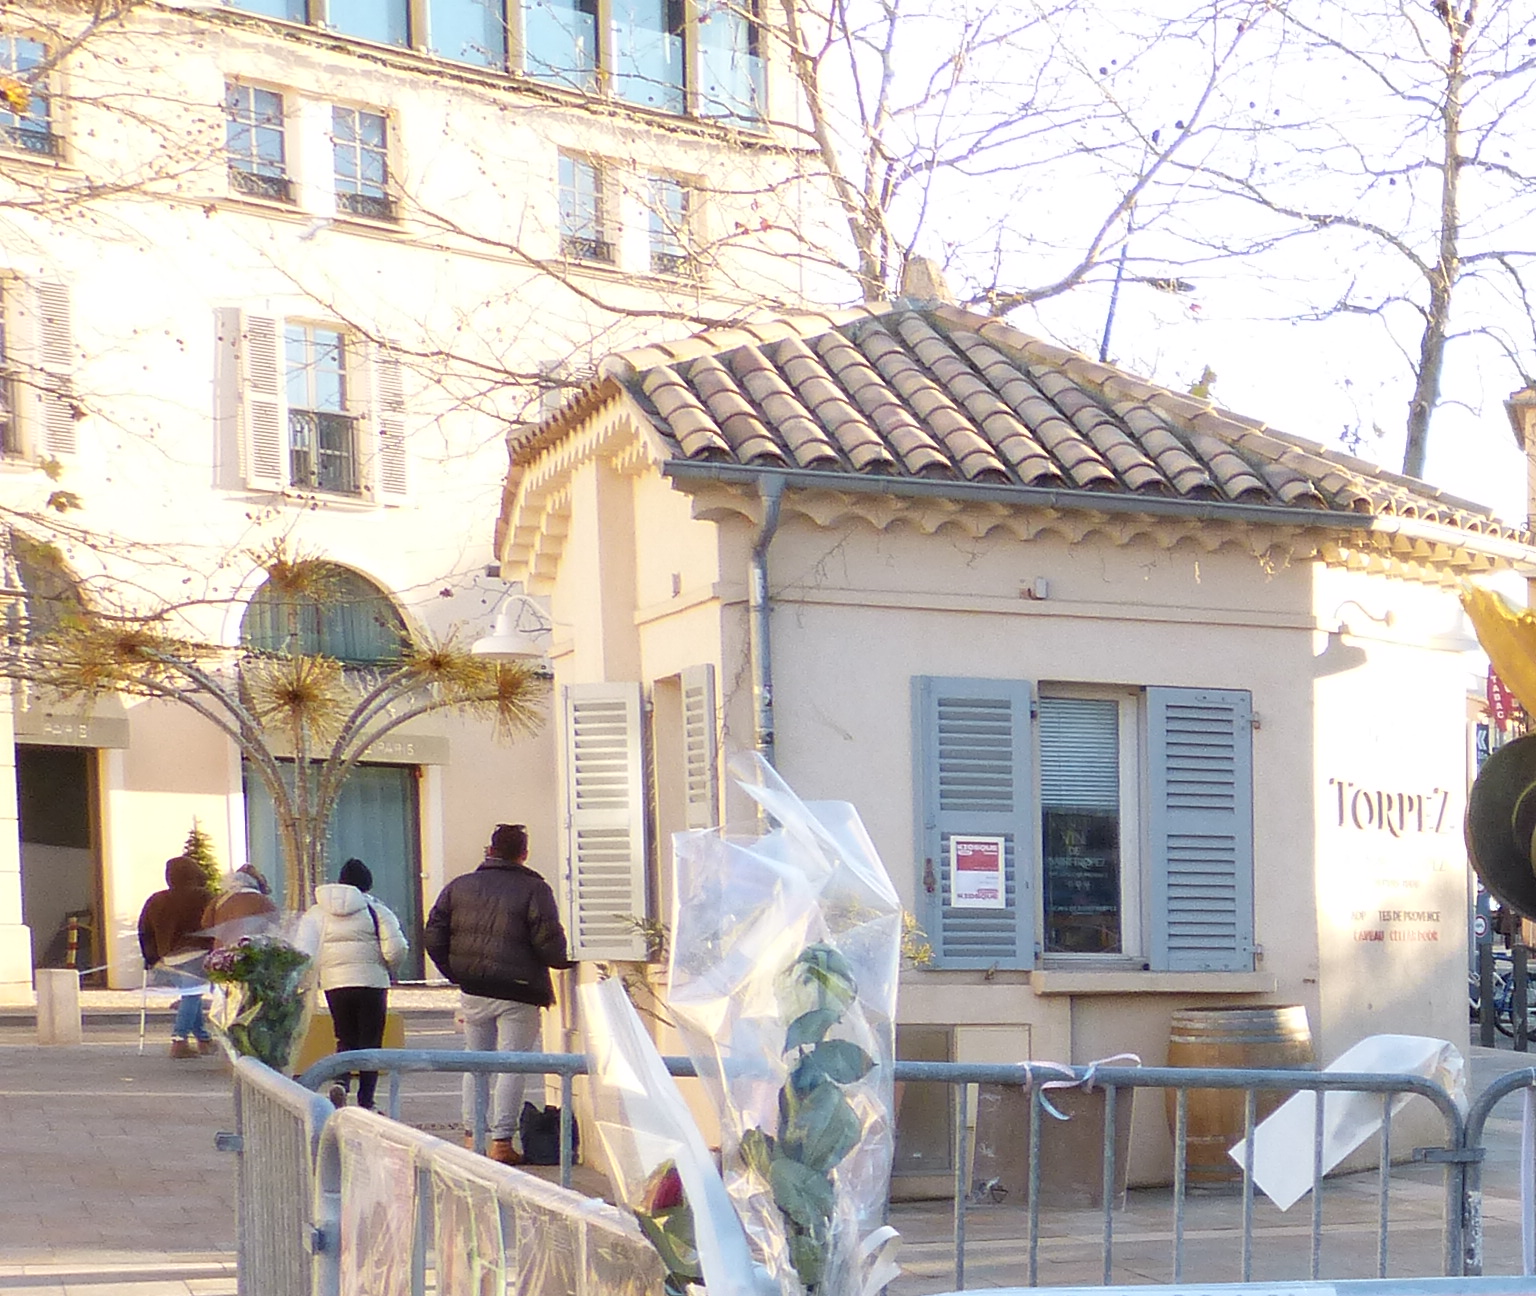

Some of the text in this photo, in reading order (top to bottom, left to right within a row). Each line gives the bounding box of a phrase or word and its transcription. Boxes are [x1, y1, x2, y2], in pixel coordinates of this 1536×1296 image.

[1490, 675, 1504, 719] TABAC
[1329, 778, 1455, 838] TORPEZ
[957, 844, 998, 852] KIOSQUE
[1403, 911, 1441, 922] PROVENCE
